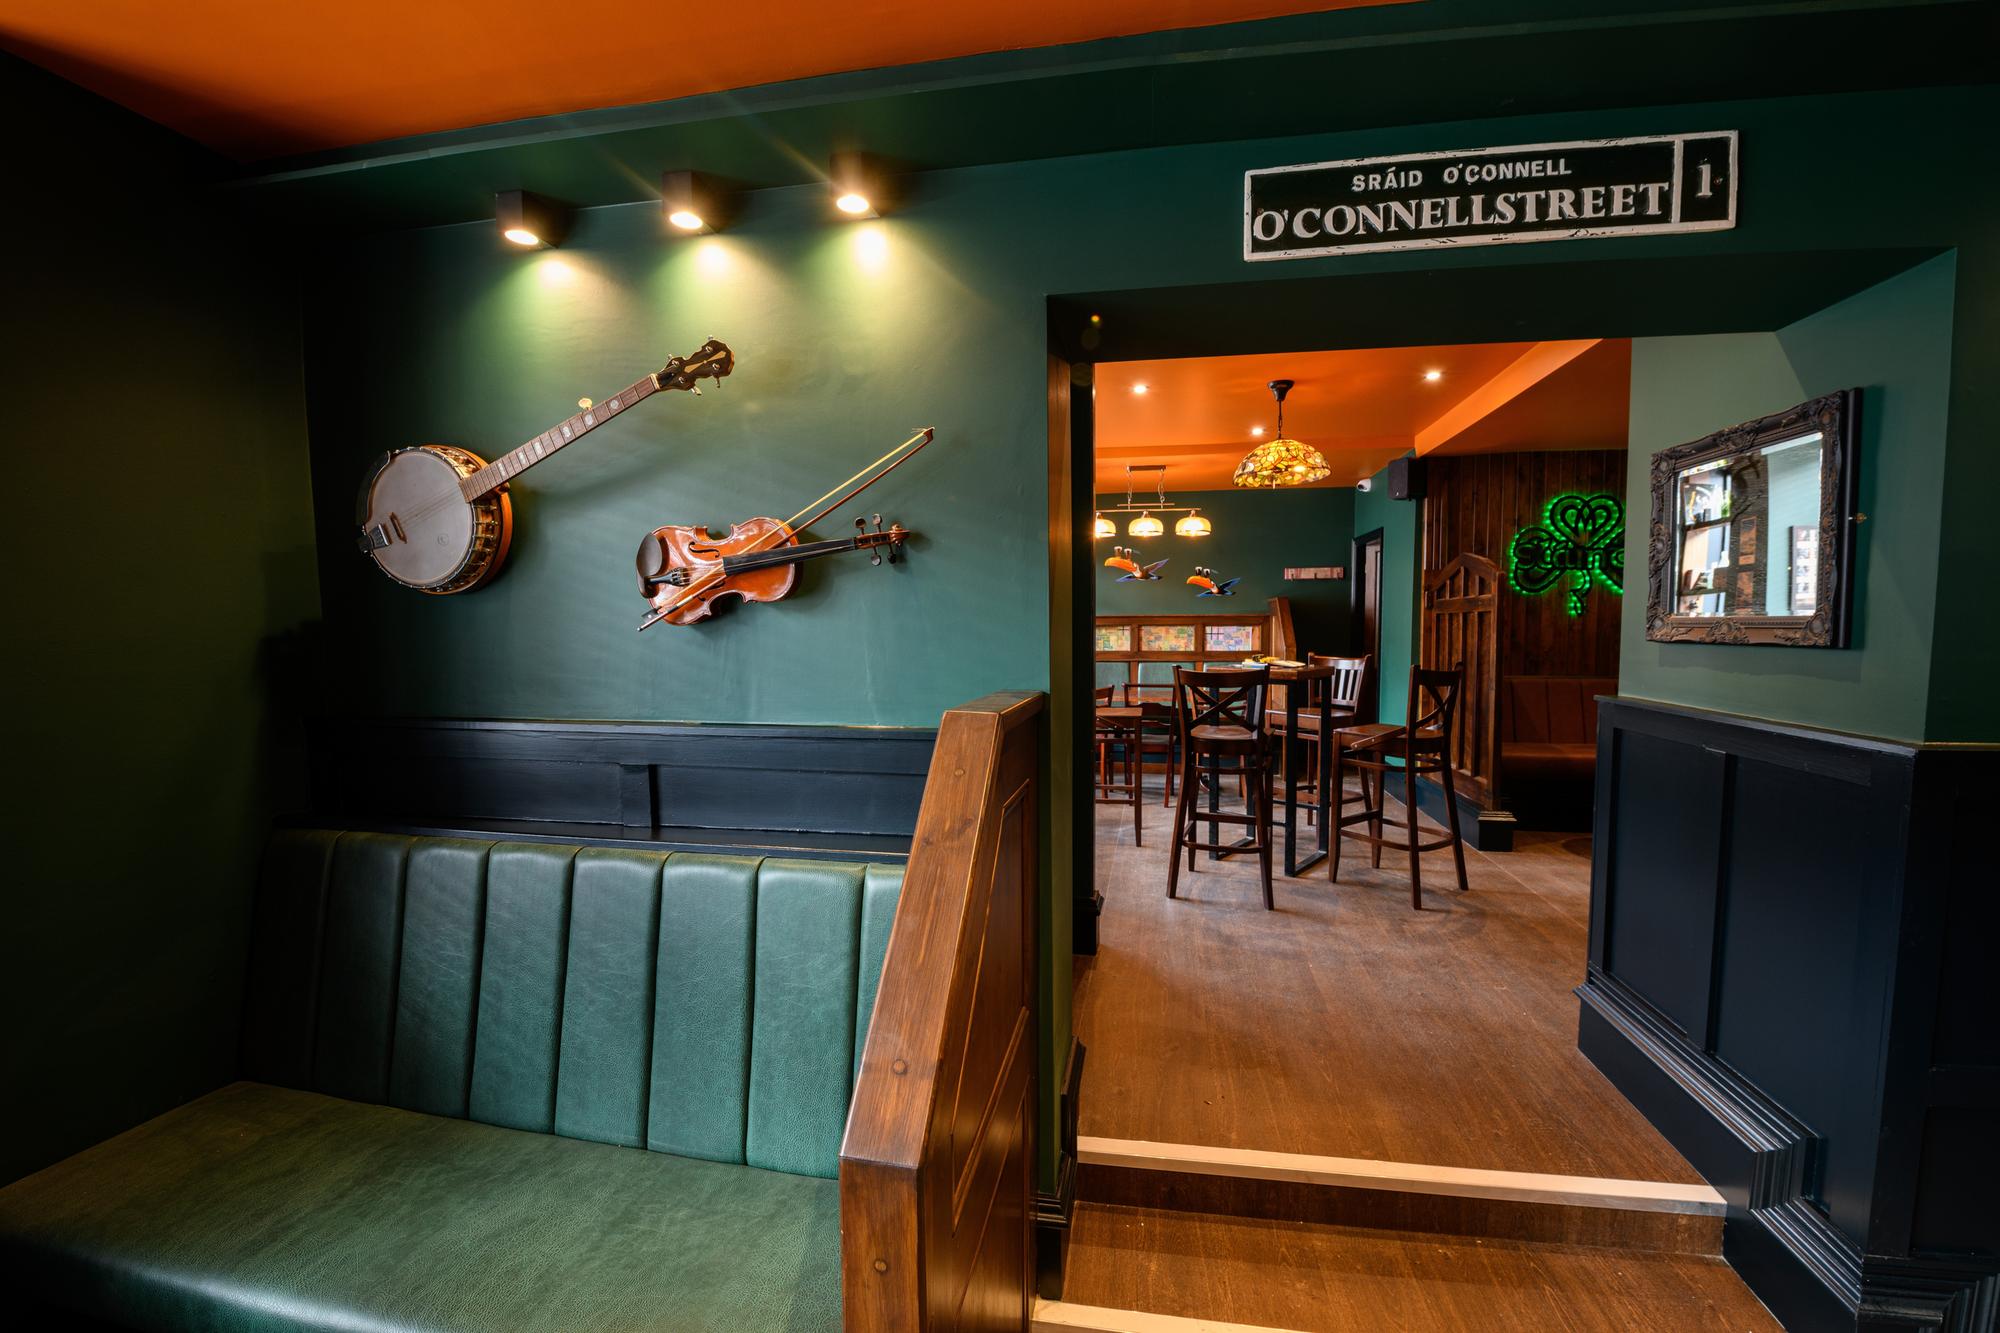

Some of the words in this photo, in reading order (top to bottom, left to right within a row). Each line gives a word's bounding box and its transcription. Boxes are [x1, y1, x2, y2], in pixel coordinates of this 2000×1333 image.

[1351, 167, 1423, 192] SRÁID
[1443, 158, 1572, 186] O'CONNELL
[1696, 162, 1713, 198] 1
